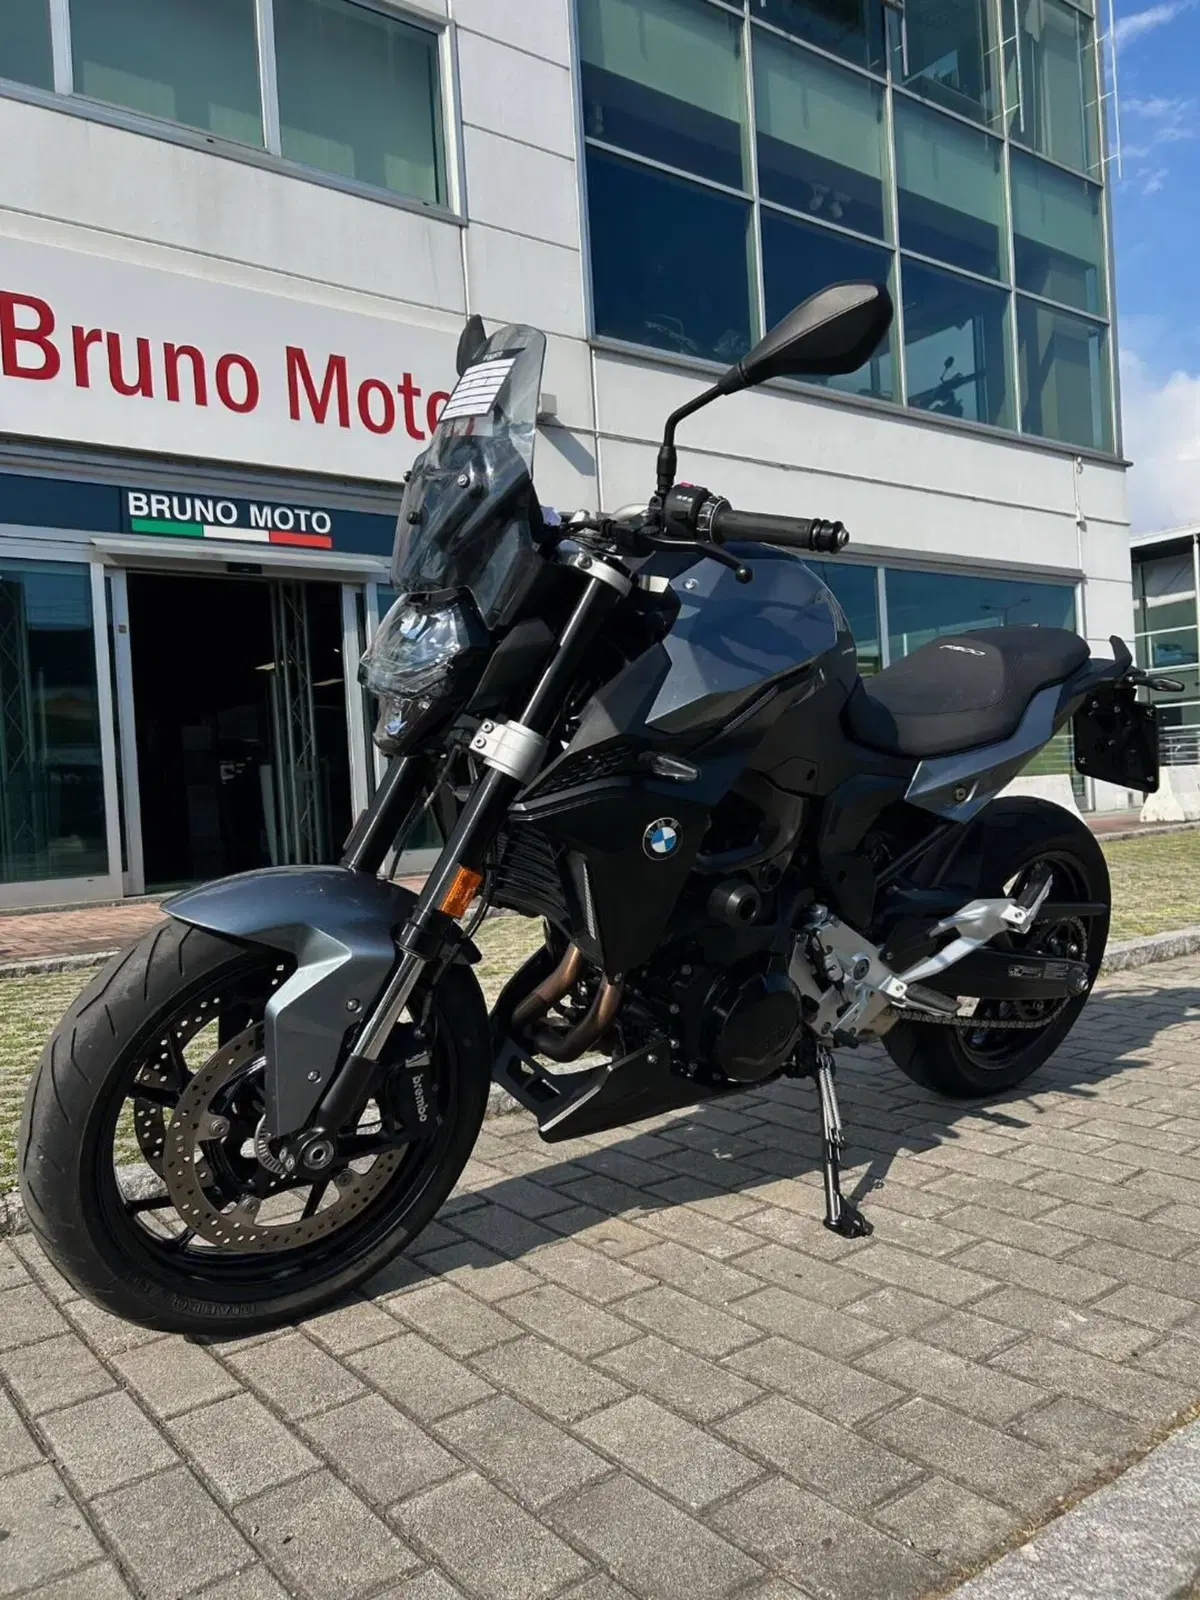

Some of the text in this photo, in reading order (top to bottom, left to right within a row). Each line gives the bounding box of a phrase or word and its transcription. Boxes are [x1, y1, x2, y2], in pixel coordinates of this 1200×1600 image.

[0, 290, 260, 413] Bruno
[128, 491, 332, 534] BRUNO MOTO
[412, 1073, 428, 1122] brembo
